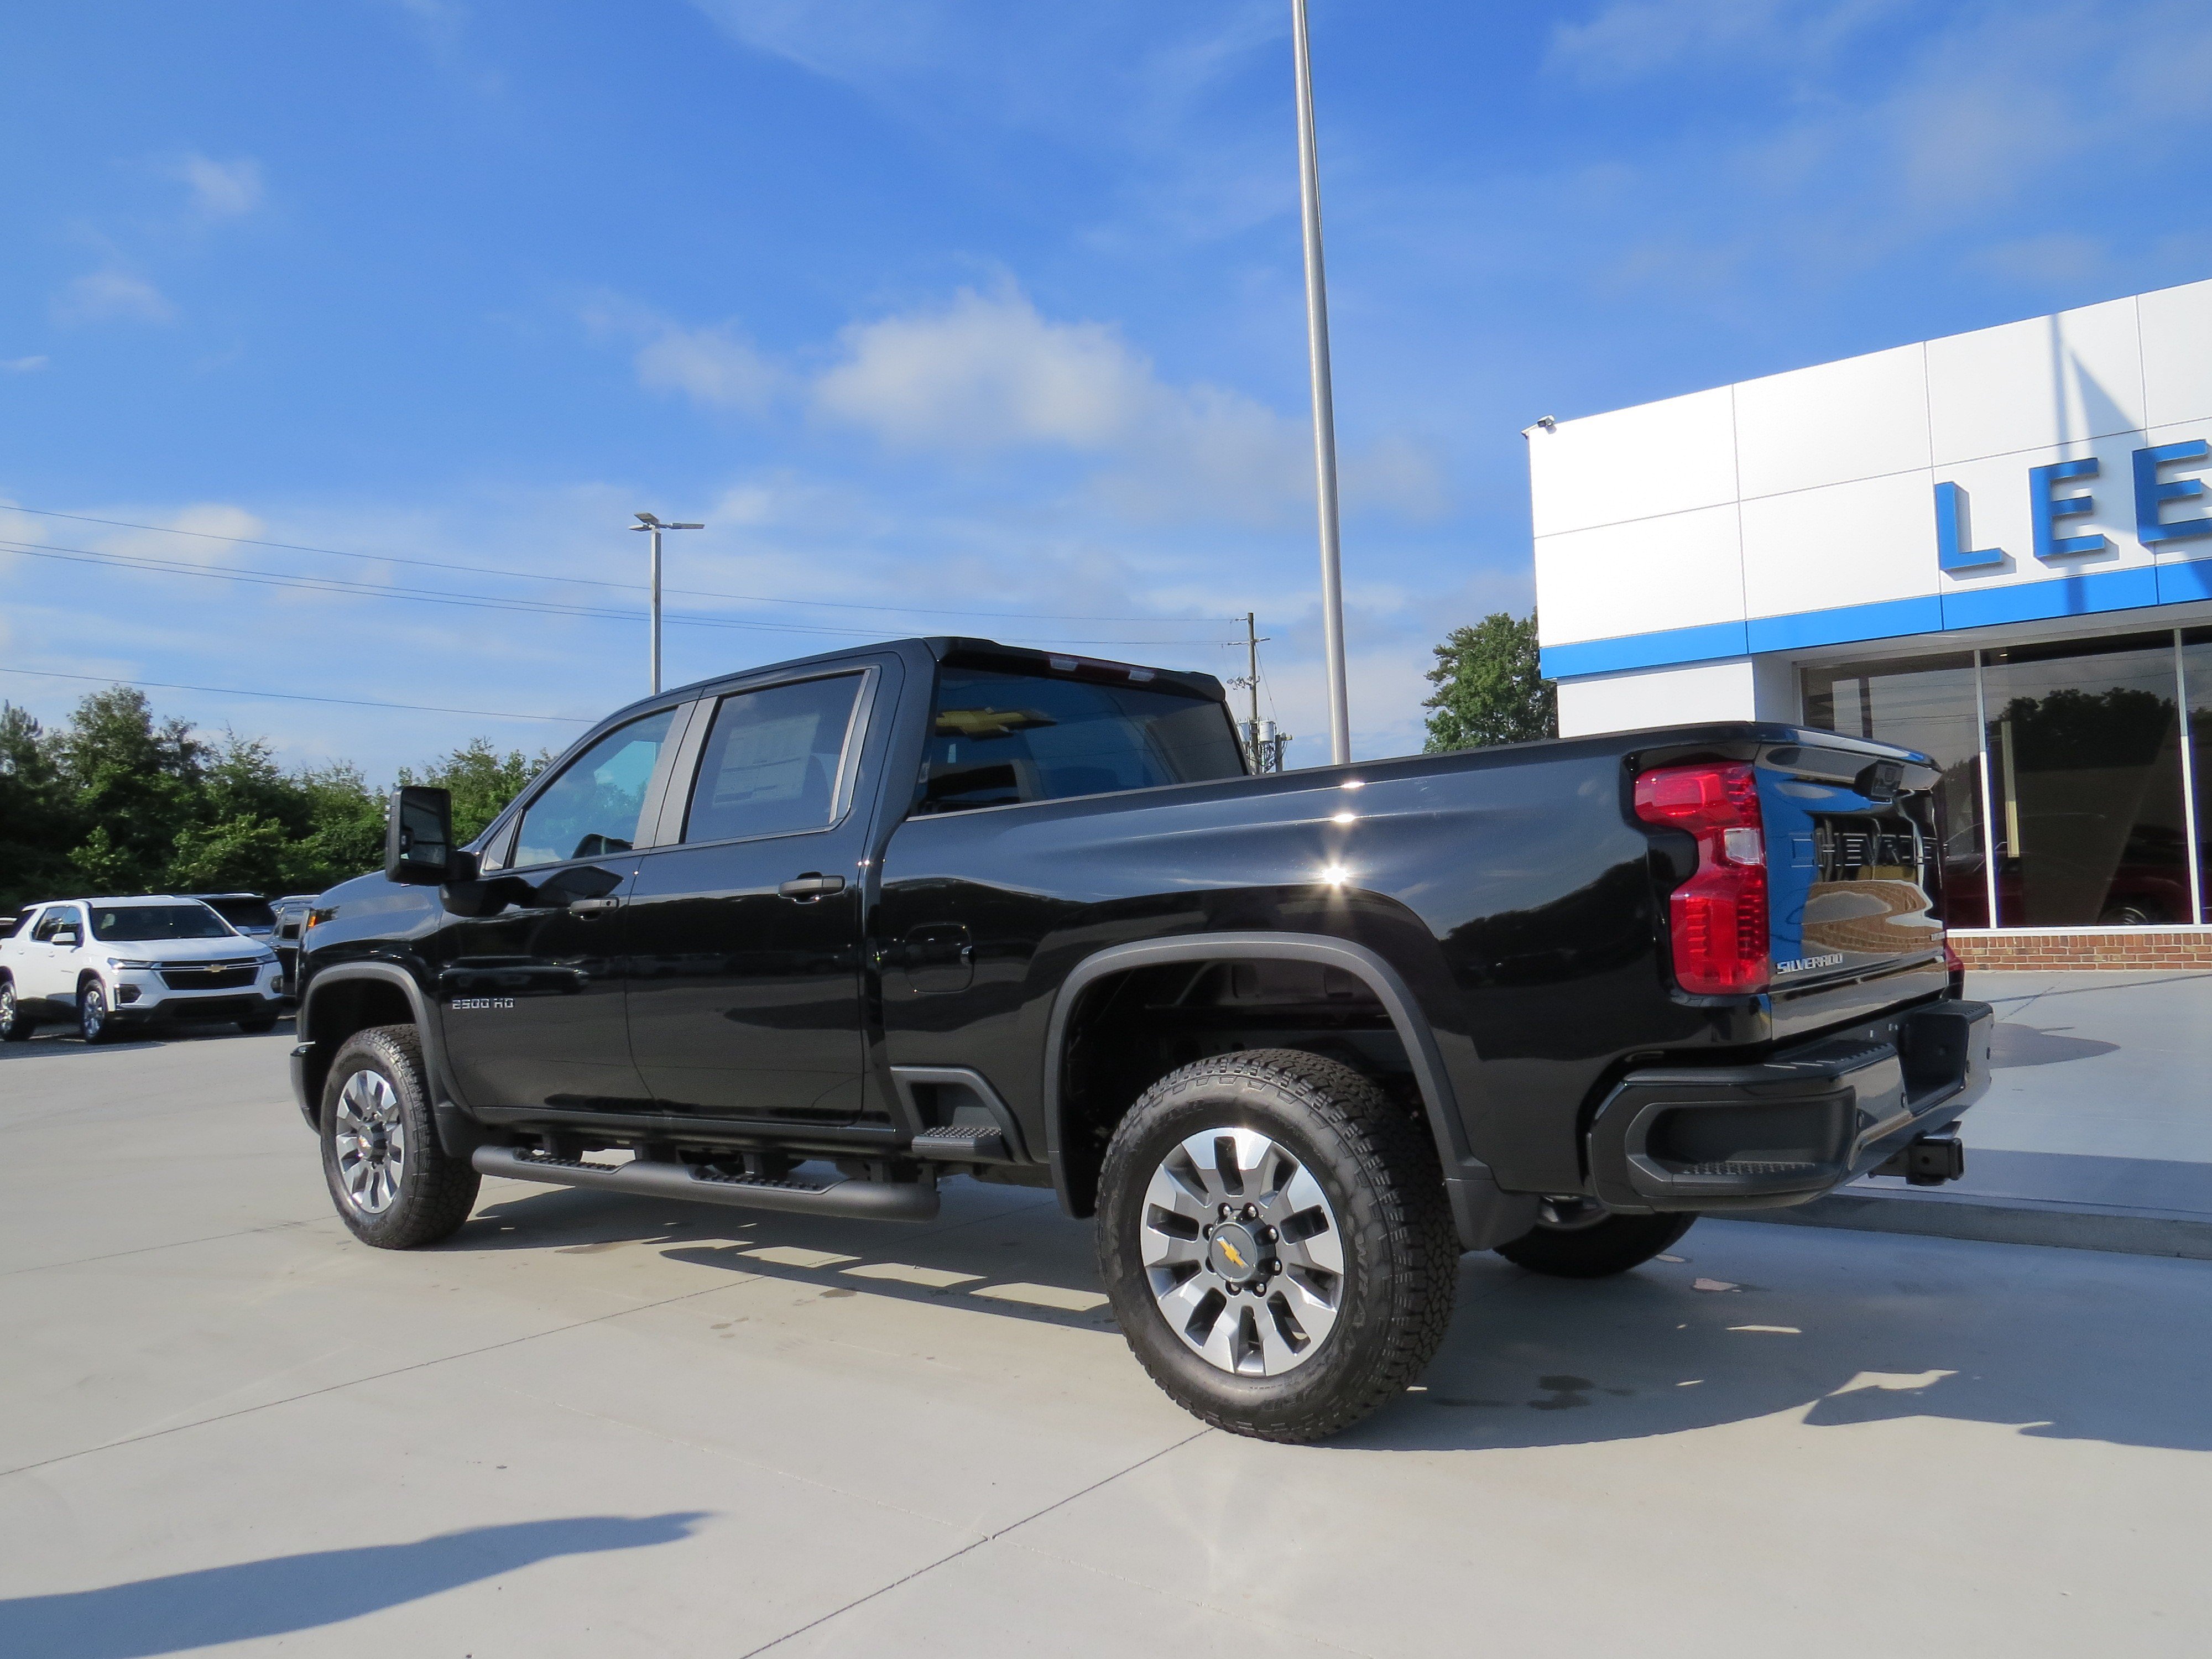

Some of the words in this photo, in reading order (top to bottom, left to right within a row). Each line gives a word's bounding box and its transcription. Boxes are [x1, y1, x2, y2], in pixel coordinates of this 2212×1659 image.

[1935, 439, 2212, 570] LEE
[1777, 953, 1843, 974] SILVERADO
[452, 998, 490, 1010] 2500
[494, 998, 515, 1009] HD
